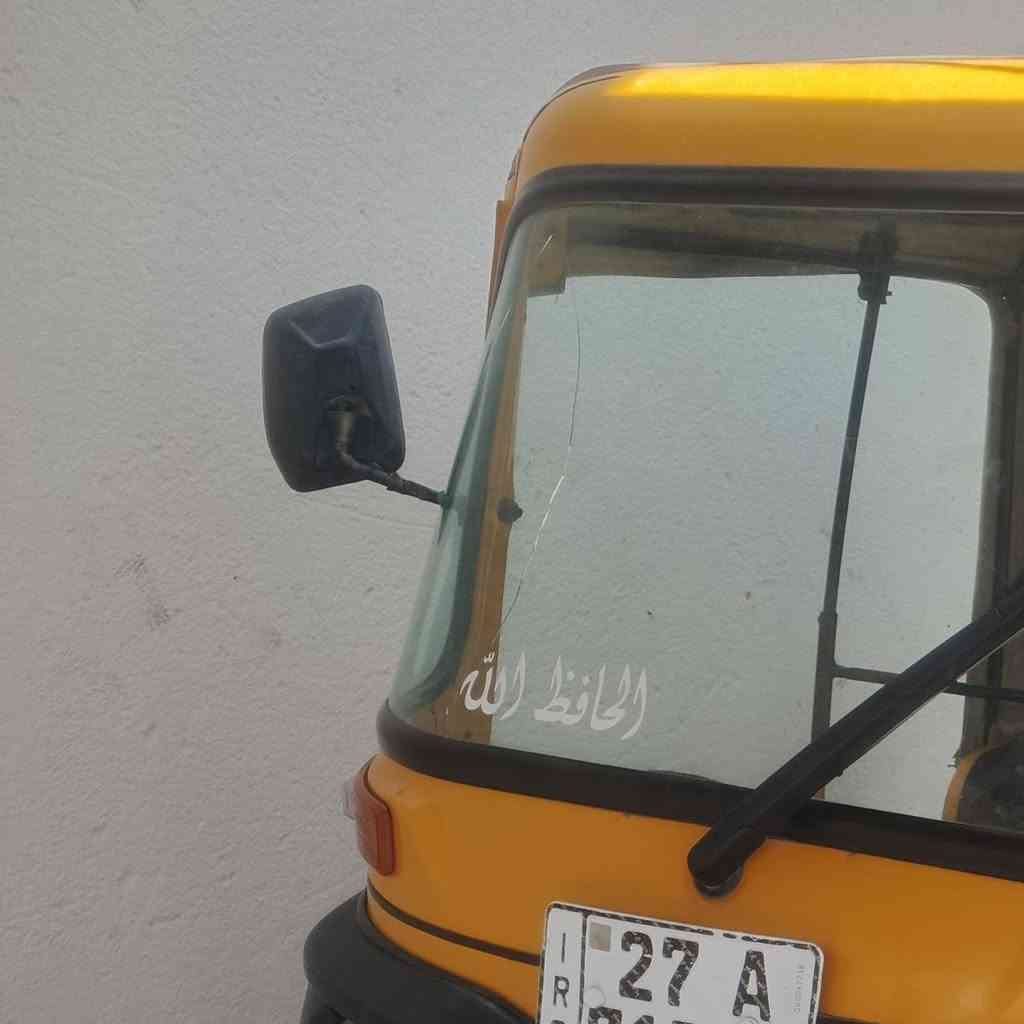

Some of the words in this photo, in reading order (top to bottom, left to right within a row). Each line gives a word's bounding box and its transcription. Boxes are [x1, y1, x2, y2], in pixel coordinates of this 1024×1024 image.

[459, 651, 527, 721] الله
[534, 655, 648, 741] الحافظ
[618, 930, 700, 1007] 27
[732, 950, 771, 1022] A
